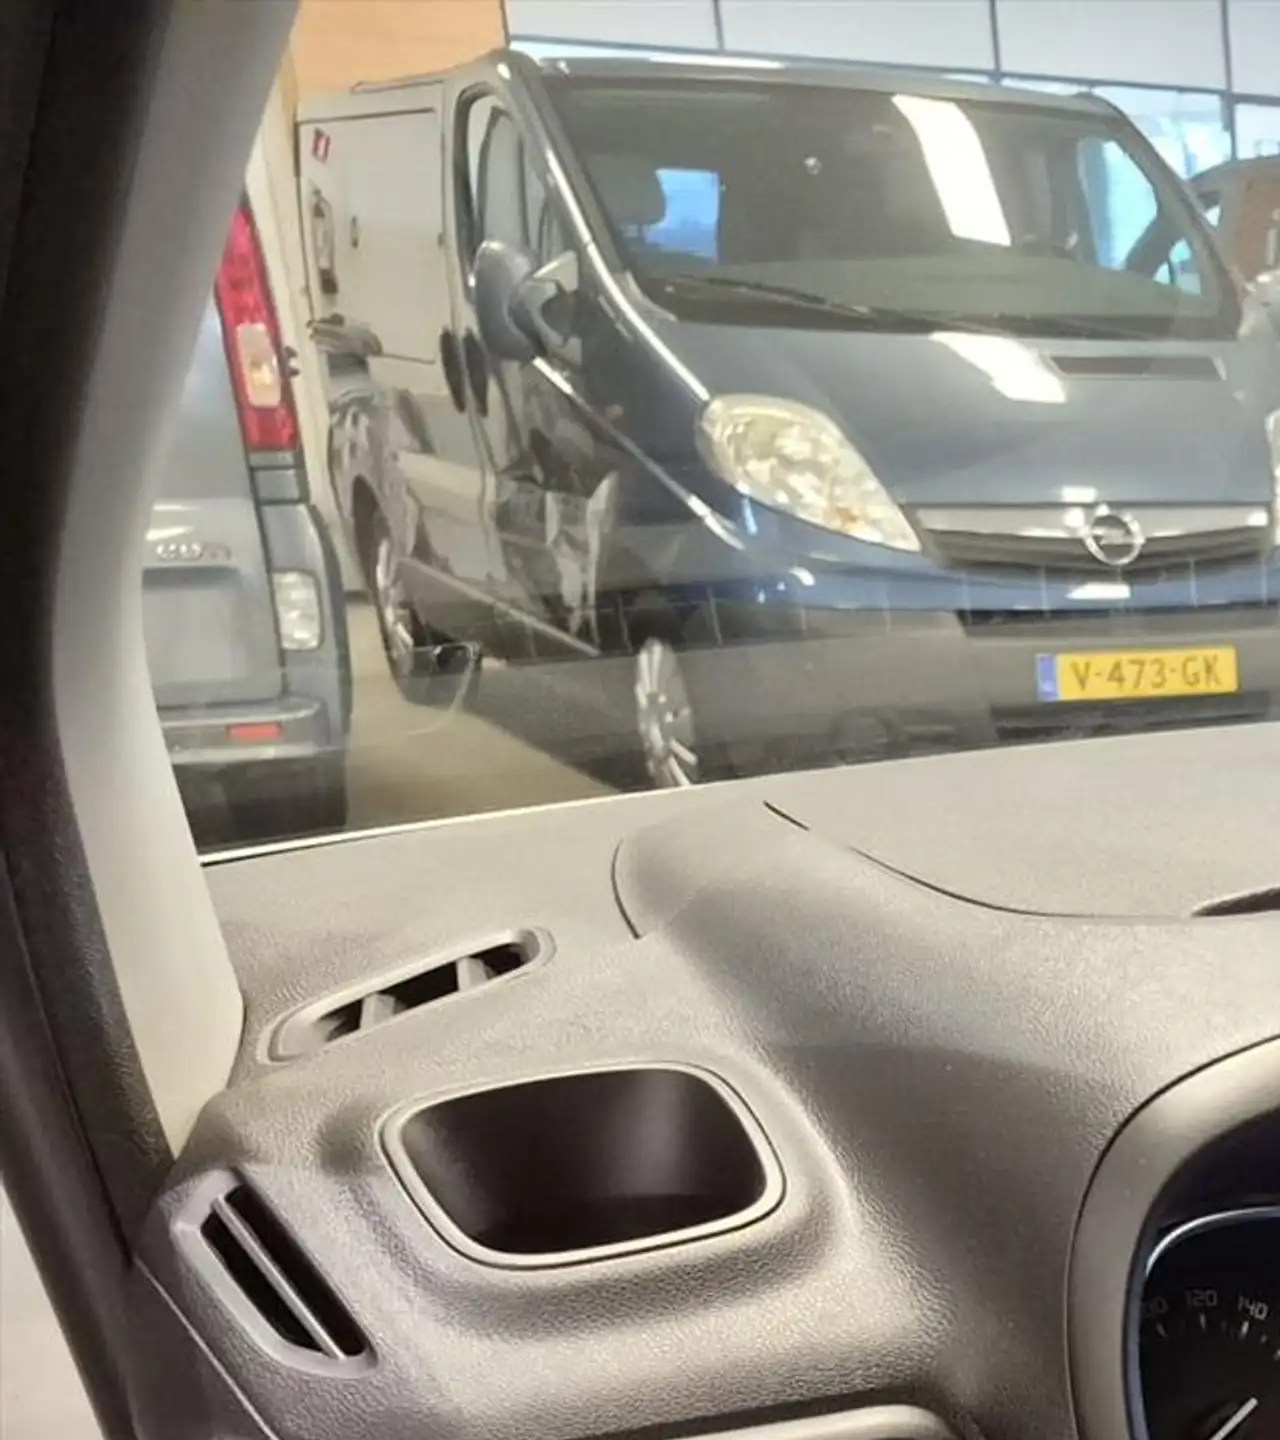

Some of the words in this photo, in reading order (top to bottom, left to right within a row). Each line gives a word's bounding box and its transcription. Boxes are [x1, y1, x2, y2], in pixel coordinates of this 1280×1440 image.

[1069, 653, 1222, 692] V-473-GK
[1186, 1289, 1218, 1307] 120
[1238, 1294, 1269, 1321] 140
